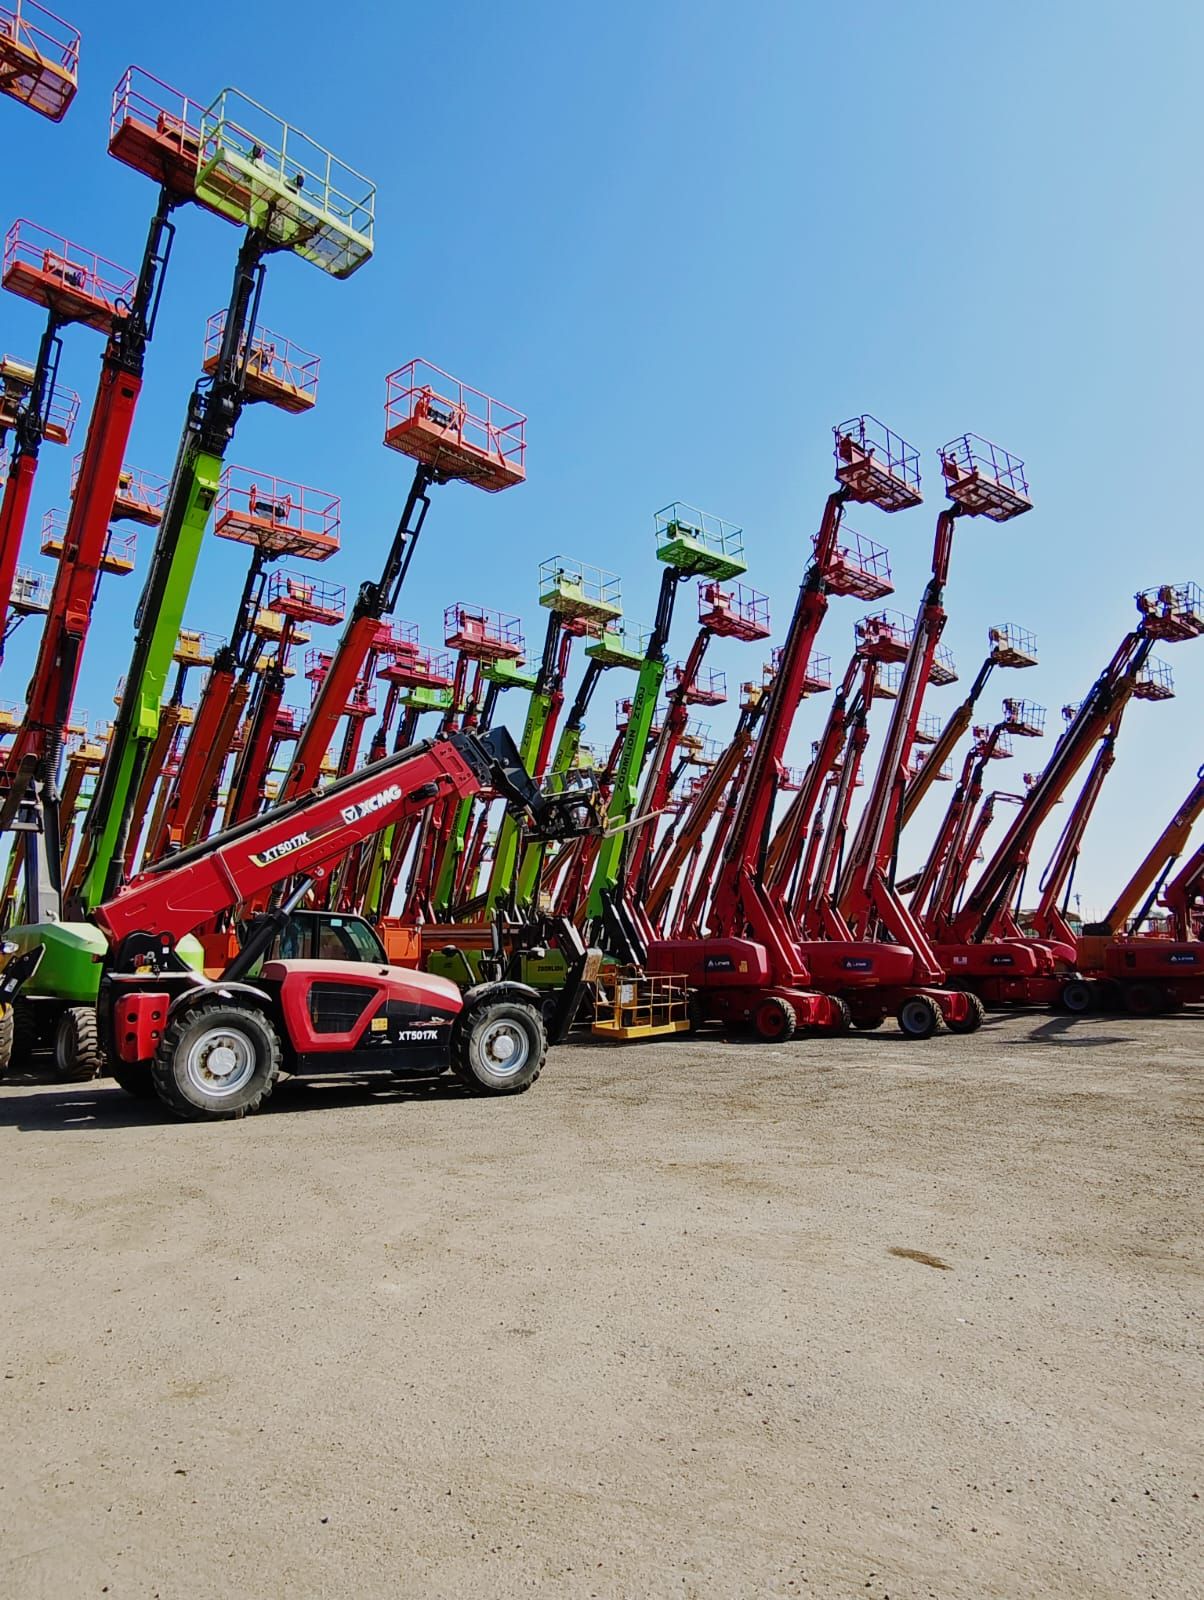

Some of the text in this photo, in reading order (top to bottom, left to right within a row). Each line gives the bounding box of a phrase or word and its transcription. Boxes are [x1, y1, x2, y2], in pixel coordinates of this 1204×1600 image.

[523, 717, 533, 746] ZT20J
[617, 686, 645, 792] ZOOMLION ZT20J
[358, 784, 402, 816] XCMG
[263, 831, 310, 861] XT5017K
[398, 1030, 438, 1041] XT5017K
